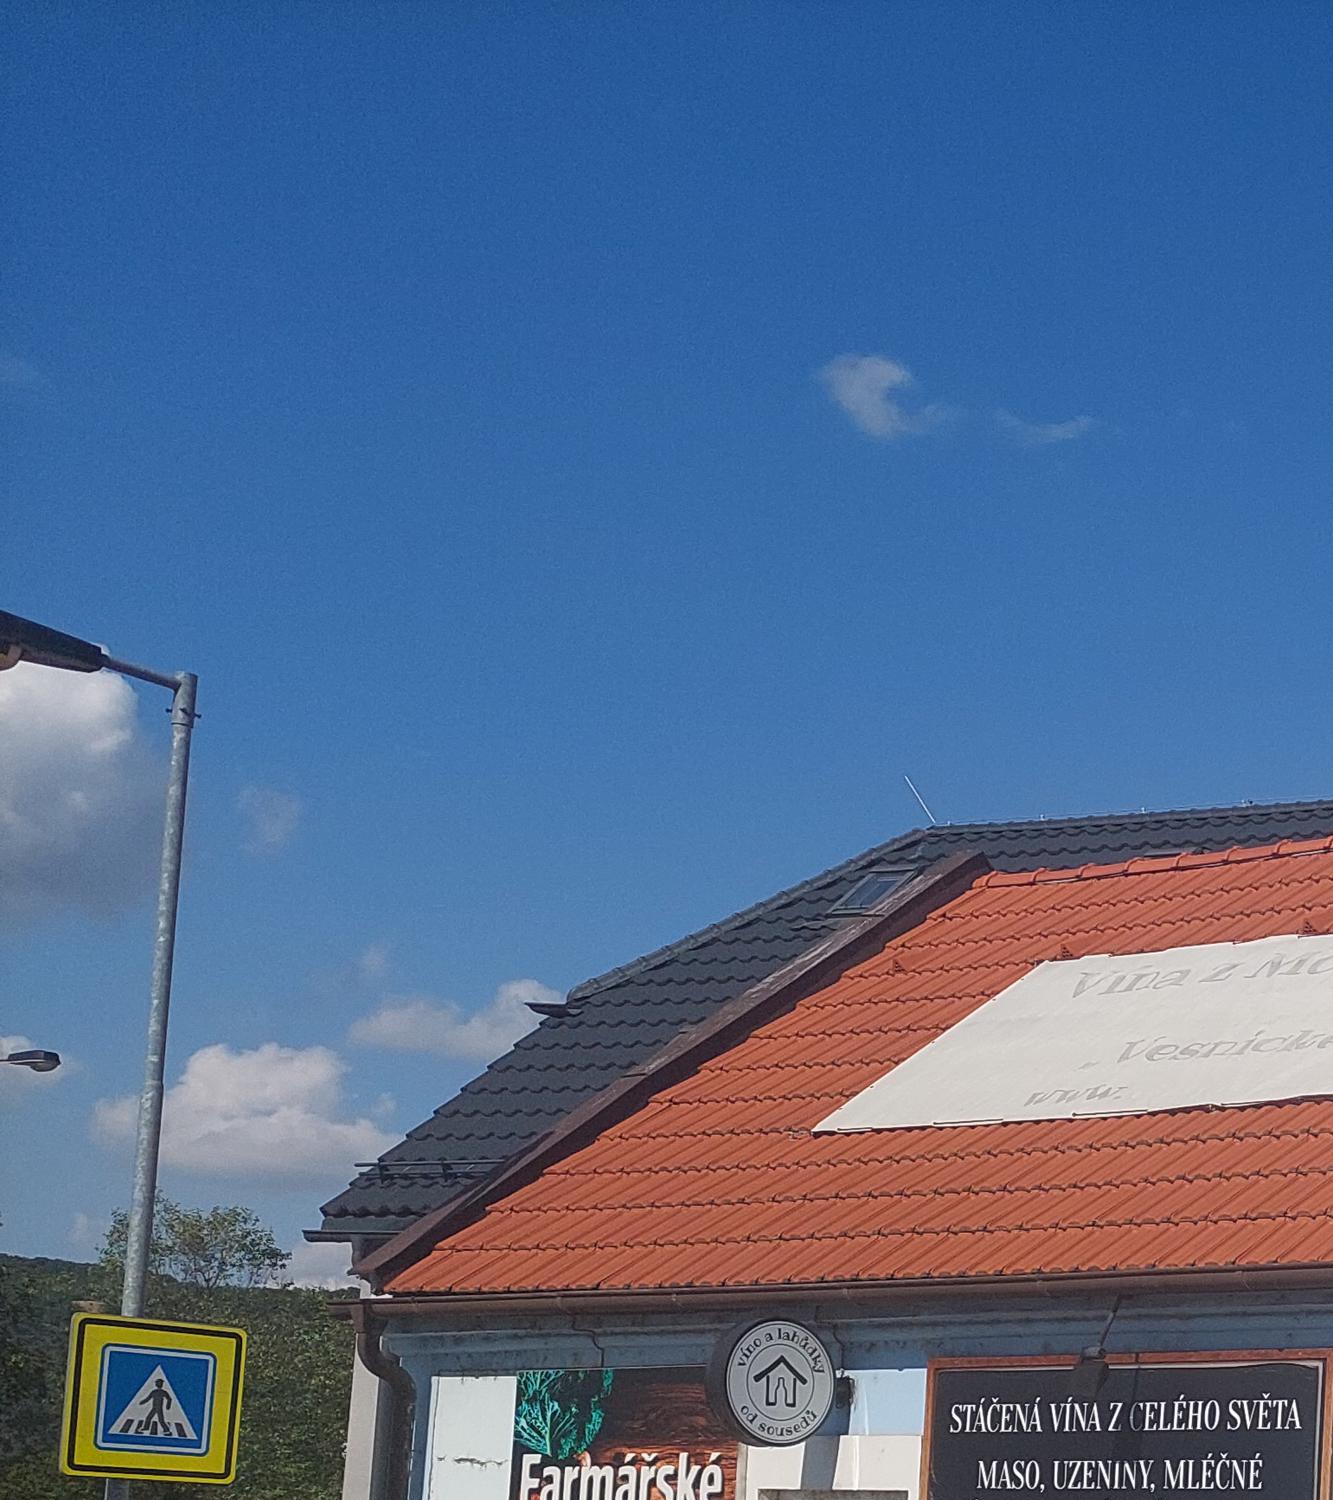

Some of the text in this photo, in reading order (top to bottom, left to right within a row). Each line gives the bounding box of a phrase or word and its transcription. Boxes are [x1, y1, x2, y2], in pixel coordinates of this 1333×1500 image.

[1200, 961, 1246, 984] z
[737, 1328, 826, 1374] víno a lahůdky
[740, 1405, 818, 1437] od sousedů
[949, 1392, 1302, 1434] STÁČENÁ VÍNA Z CELÉHO SVĚTA
[976, 1452, 1264, 1494] MASO, UZENINY, MLÉČNÉ
